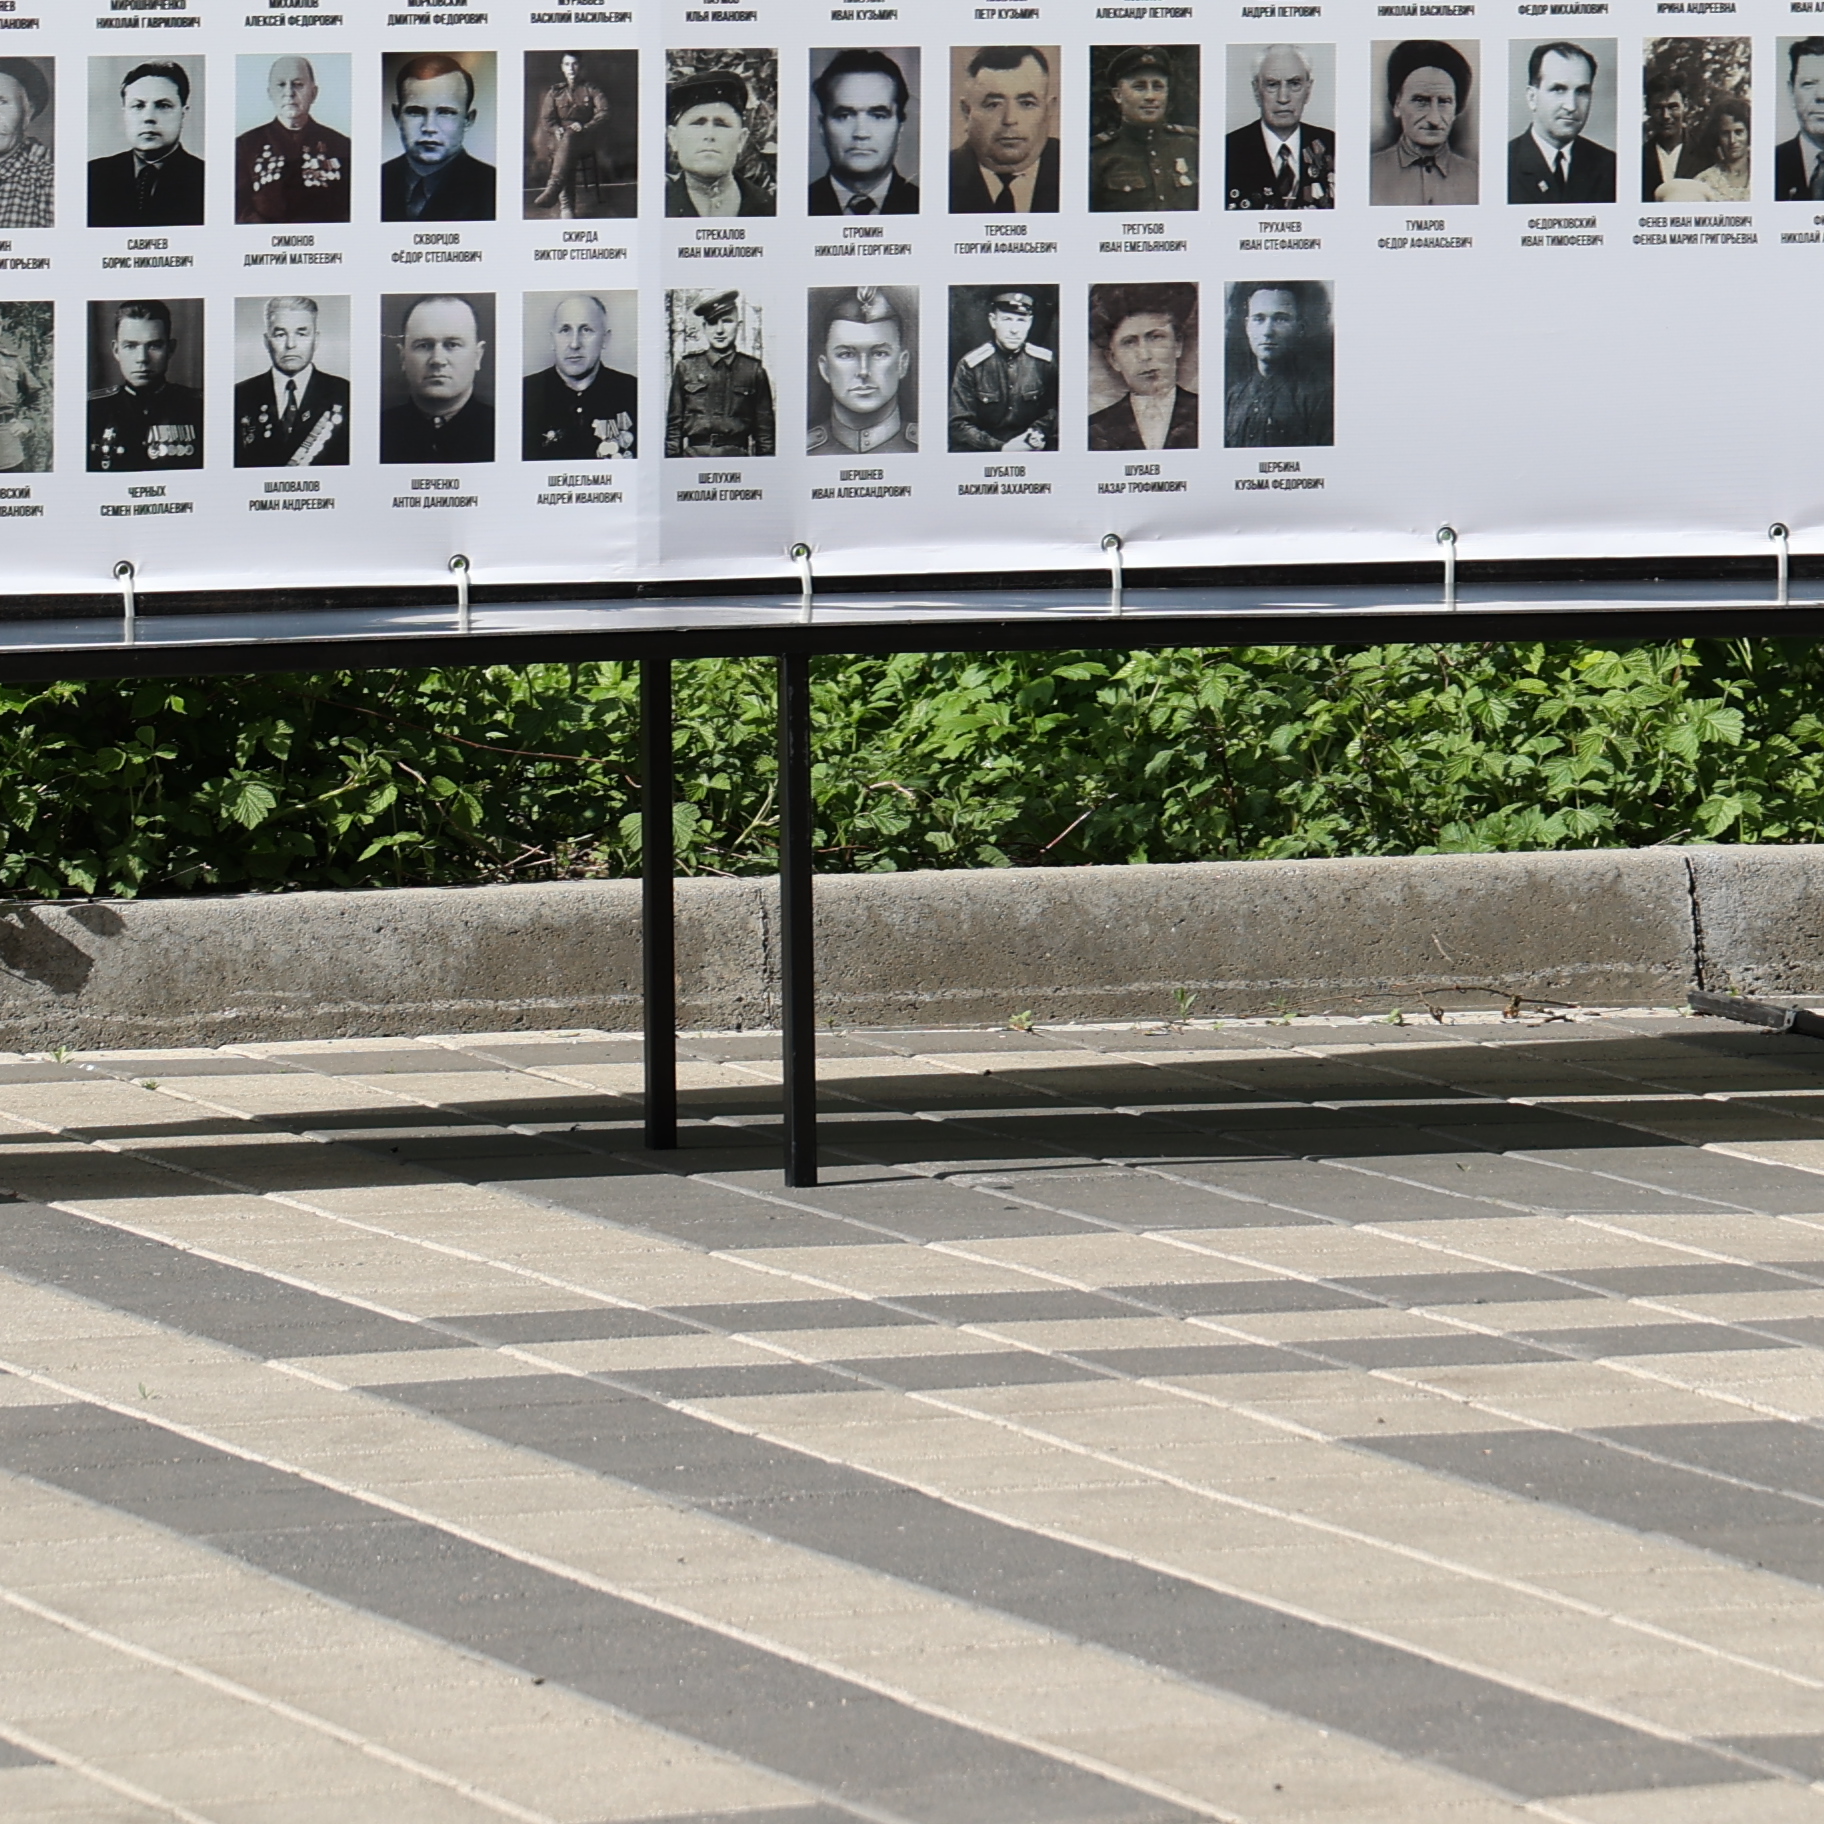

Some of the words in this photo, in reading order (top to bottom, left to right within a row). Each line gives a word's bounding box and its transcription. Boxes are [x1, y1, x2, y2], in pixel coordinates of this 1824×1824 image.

[1656, 2, 1685, 14] ИРИНА
[1686, 2, 1737, 15] АНДРЕЕВНА
[530, 10, 572, 24] ВАСИЛИЙ
[574, 11, 632, 24] ВАСИЛЬЕВИЧ
[413, 233, 460, 246] СКВОРЦОВ
[562, 230, 599, 244] СКИРДА
[696, 228, 746, 241] СТРЕКАЛОВ
[271, 235, 315, 248] СИМОНОВ
[1239, 239, 1262, 251] ИВАН
[1264, 238, 1321, 251] СТЕФАНОВИЧ
[424, 250, 482, 263] СТЕПАНОВИЧ
[534, 248, 568, 261] ВИКТОР
[570, 248, 627, 261] СТЕПАНОВИЧ
[678, 246, 702, 259] ИВАН
[703, 244, 764, 259] МИХАЙЛОВИЧ
[243, 253, 288, 267] ДМИТРИЙ
[289, 252, 342, 265] МАТВЕЕВИЧ
[264, 480, 320, 494] ШАПОВАЛОВ
[411, 478, 460, 491] ШЕВЧЕНКО
[1234, 478, 1270, 491] КУЗЬМА
[1271, 477, 1325, 491] ФЕДОРОВИЧ
[248, 499, 280, 512] РОМАН
[281, 497, 335, 512] АНДРЕЕВИЧ
[392, 496, 422, 508] АНТОН
[422, 495, 478, 509] ДАНИЛОВИЧ
